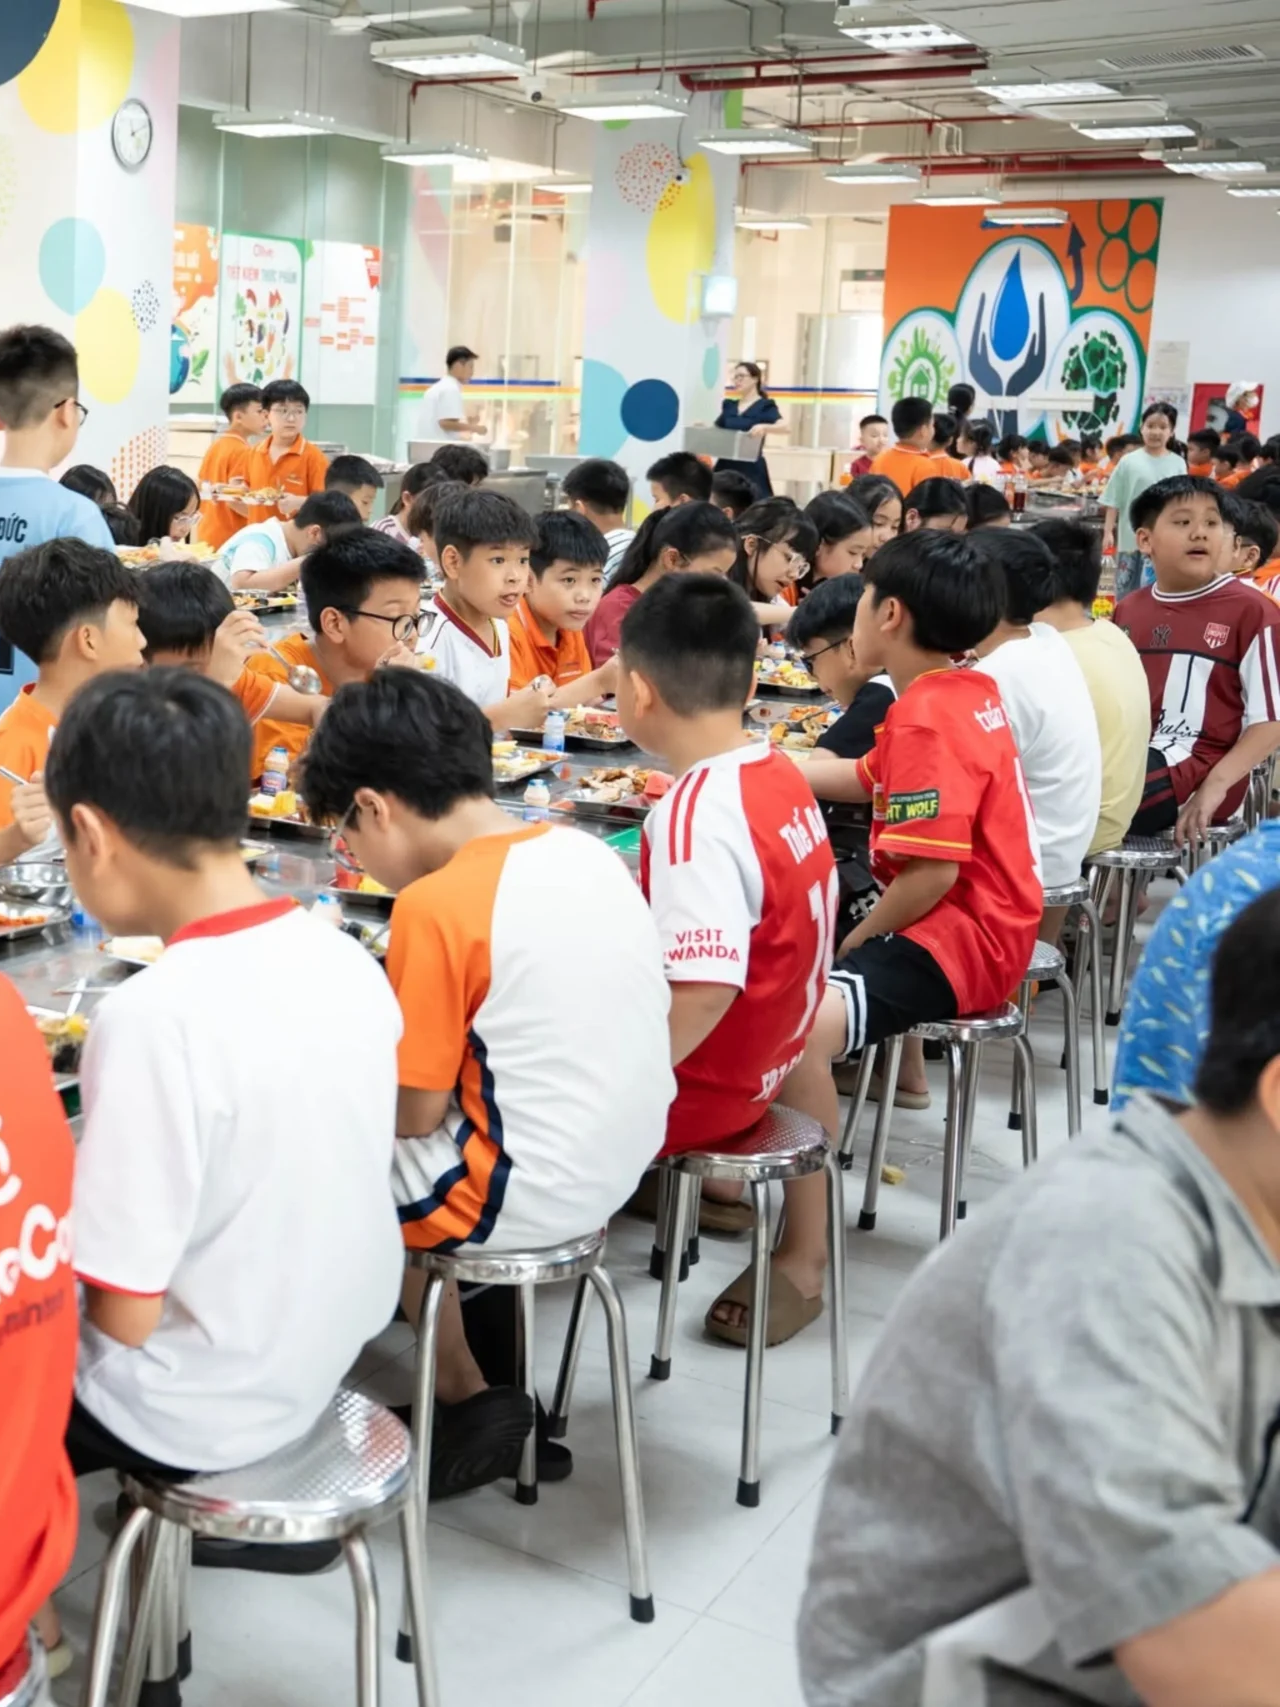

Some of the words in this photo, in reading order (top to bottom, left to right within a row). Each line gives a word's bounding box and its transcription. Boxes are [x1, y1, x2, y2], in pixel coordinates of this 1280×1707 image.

[906, 799, 939, 819] WOLF
[675, 928, 723, 945] VISIT
[664, 944, 740, 963] WANDA
